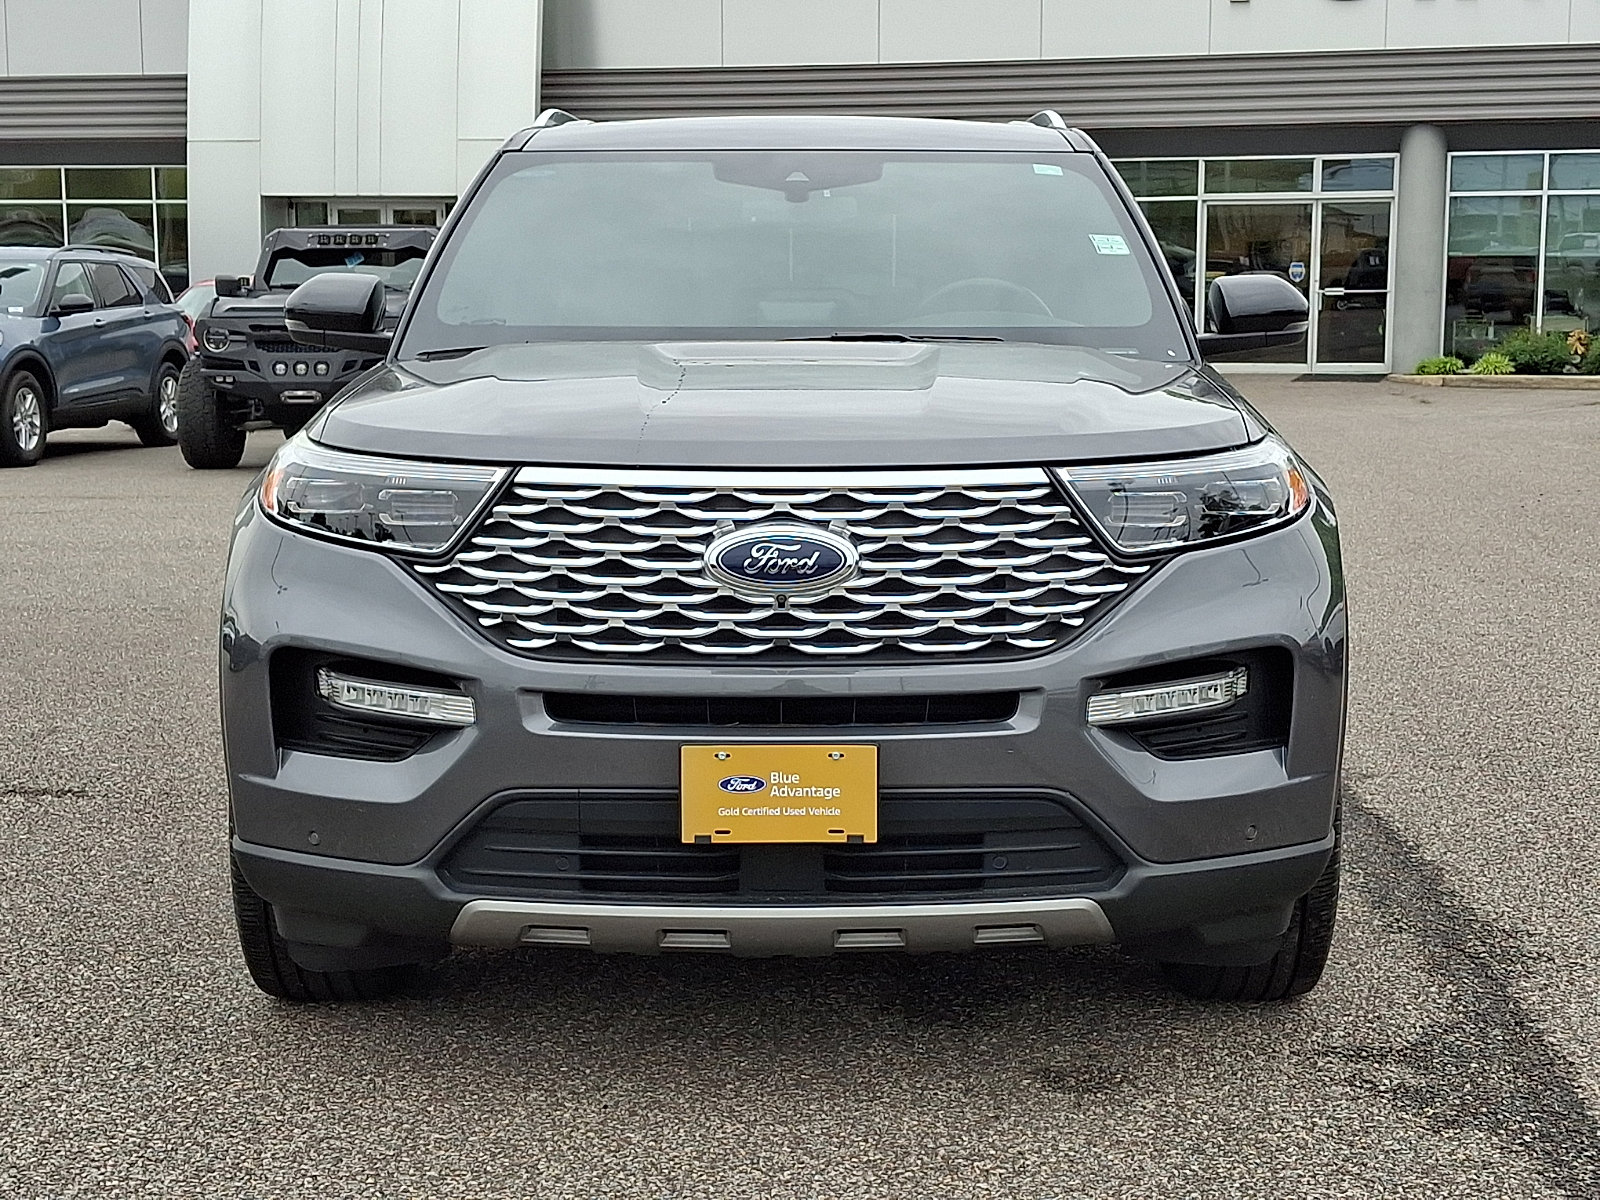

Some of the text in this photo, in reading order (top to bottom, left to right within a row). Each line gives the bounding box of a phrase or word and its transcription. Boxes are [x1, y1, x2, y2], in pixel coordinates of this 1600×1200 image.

[743, 542, 821, 575] Ford
[726, 777, 757, 791] Ford
[770, 771, 800, 784] Blue
[769, 785, 841, 800] Advantage
[718, 806, 841, 816] Gold Certified Used Vehicle
